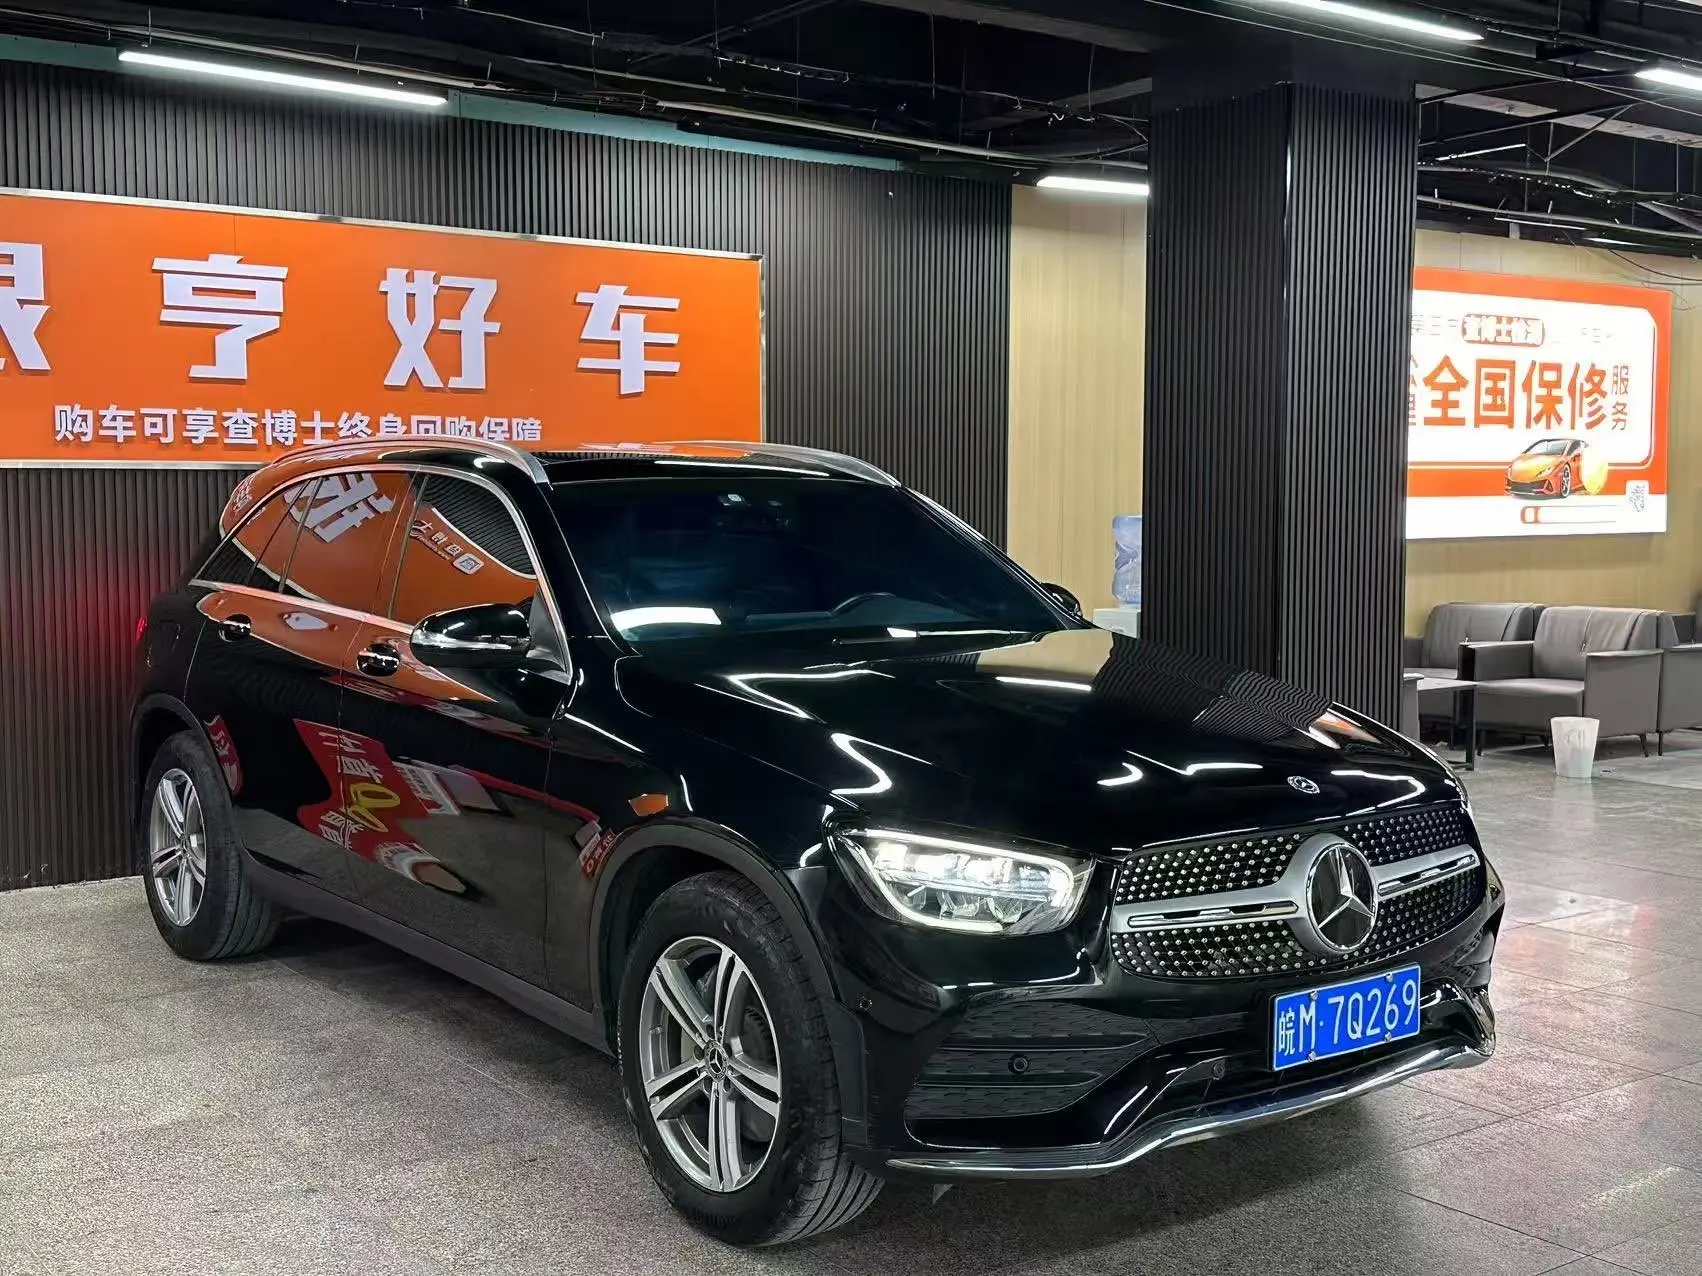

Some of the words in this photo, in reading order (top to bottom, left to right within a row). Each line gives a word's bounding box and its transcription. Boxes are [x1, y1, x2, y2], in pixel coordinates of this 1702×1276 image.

[1423, 355, 1608, 431] 全国保修
[1611, 364, 1630, 432] 服务
